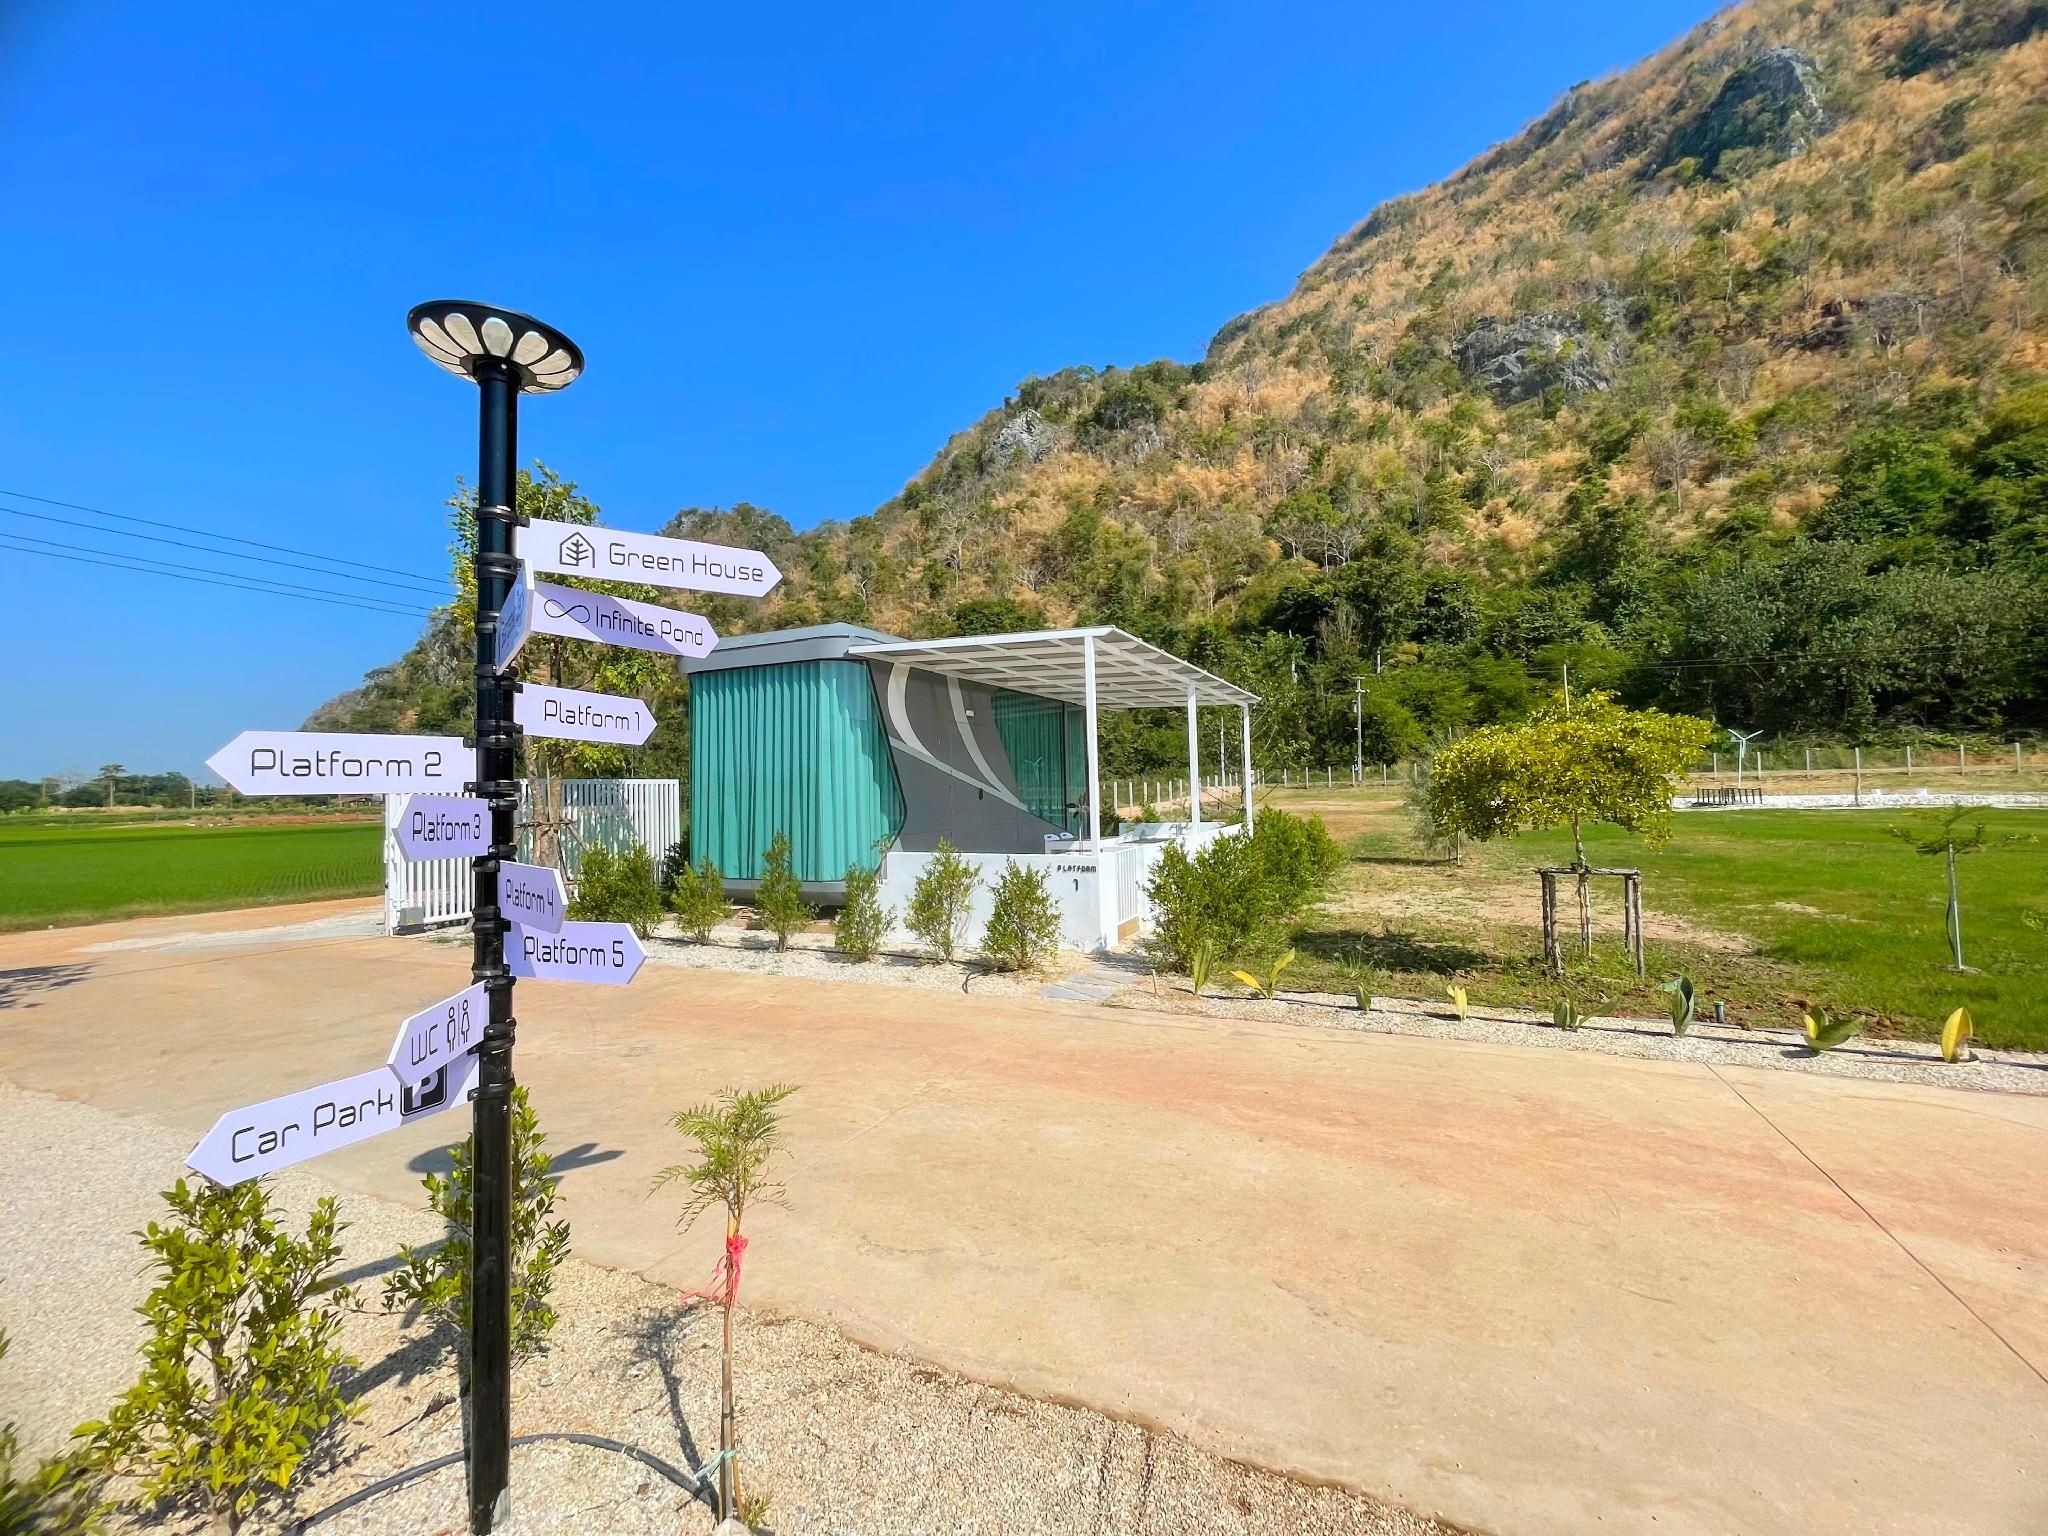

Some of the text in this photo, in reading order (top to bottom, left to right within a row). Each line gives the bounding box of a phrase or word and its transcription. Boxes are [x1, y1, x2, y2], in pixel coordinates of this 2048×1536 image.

[609, 542, 763, 582] Green House
[596, 605, 703, 646] Infinite Pond
[544, 699, 640, 731] Platform 1
[251, 748, 442, 777] Platform 2
[412, 811, 481, 842] Platform 3
[1057, 864, 1097, 873] PLATFORM
[1073, 878, 1079, 891] 1
[506, 878, 554, 916] Platform 4
[524, 936, 624, 968] Platform 5
[411, 1023, 439, 1066] WC
[232, 1070, 439, 1163] Car Park P
